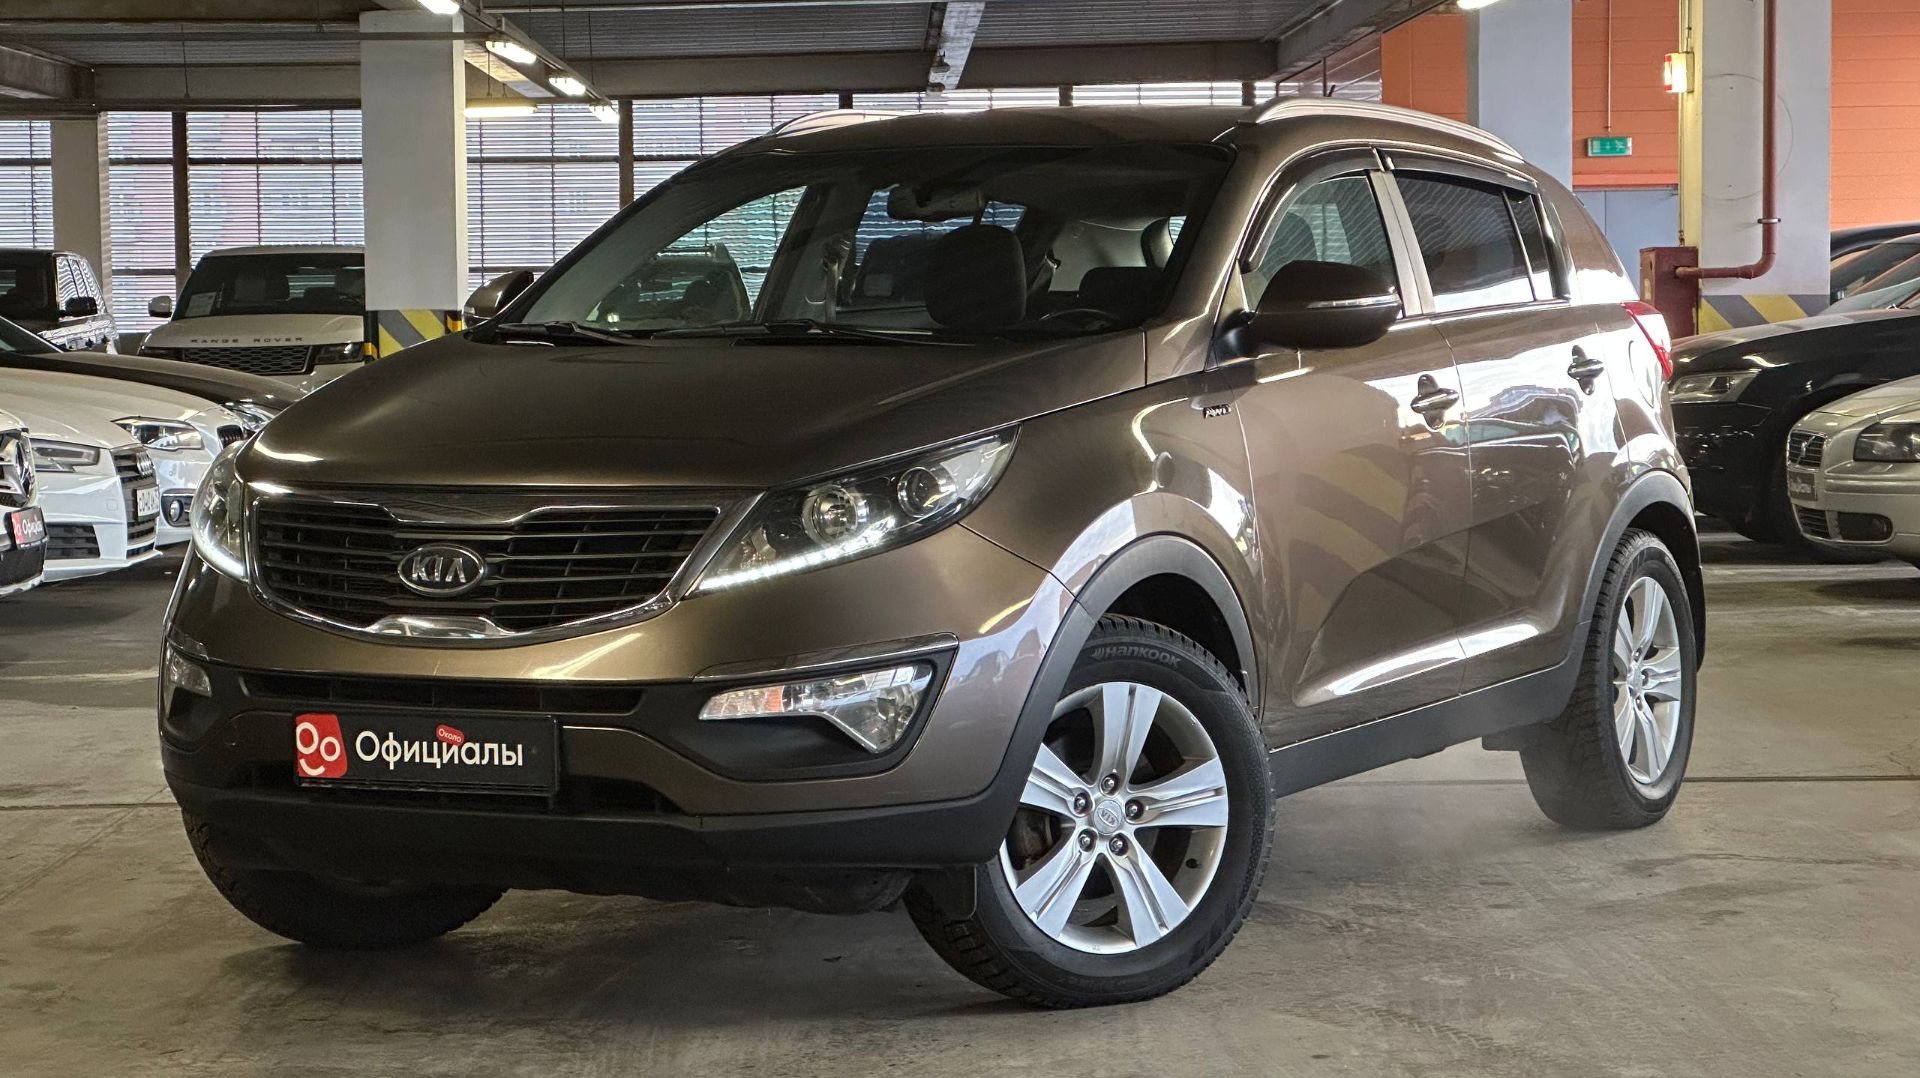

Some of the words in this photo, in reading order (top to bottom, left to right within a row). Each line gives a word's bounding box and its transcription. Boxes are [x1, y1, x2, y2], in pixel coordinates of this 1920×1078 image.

[411, 556, 466, 583] KIA
[438, 728, 462, 743] Около
[355, 730, 523, 770] Официалы
